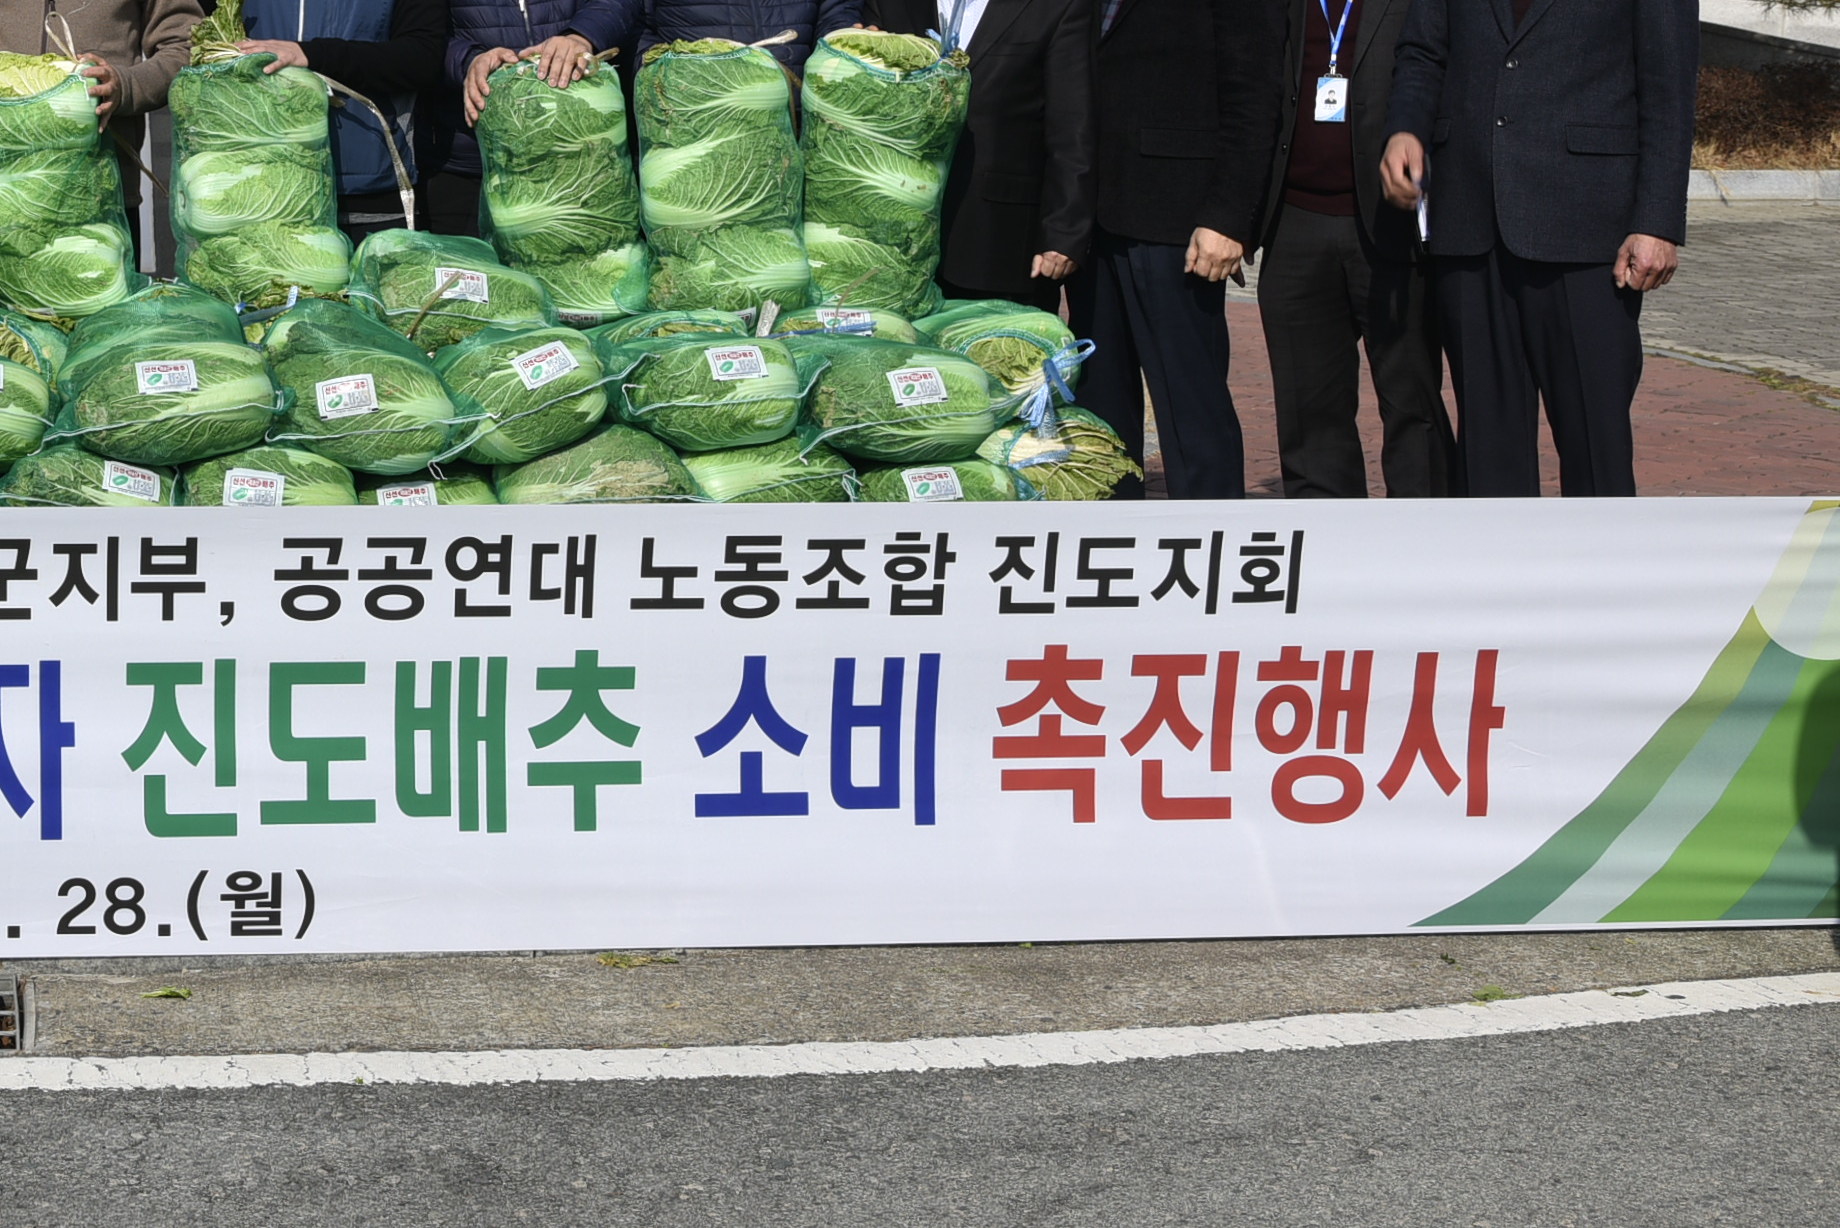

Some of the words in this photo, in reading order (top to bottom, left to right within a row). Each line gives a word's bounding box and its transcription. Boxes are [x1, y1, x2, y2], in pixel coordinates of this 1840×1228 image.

[275, 534, 596, 621] 공공연대
[630, 532, 956, 618] 노동조합
[989, 531, 1304, 614] 진도지회
[121, 650, 642, 838] 진도배추
[695, 653, 941, 826] 소비
[992, 645, 1506, 824] 촉진행사
[57, 870, 315, 941] 28.(월)
